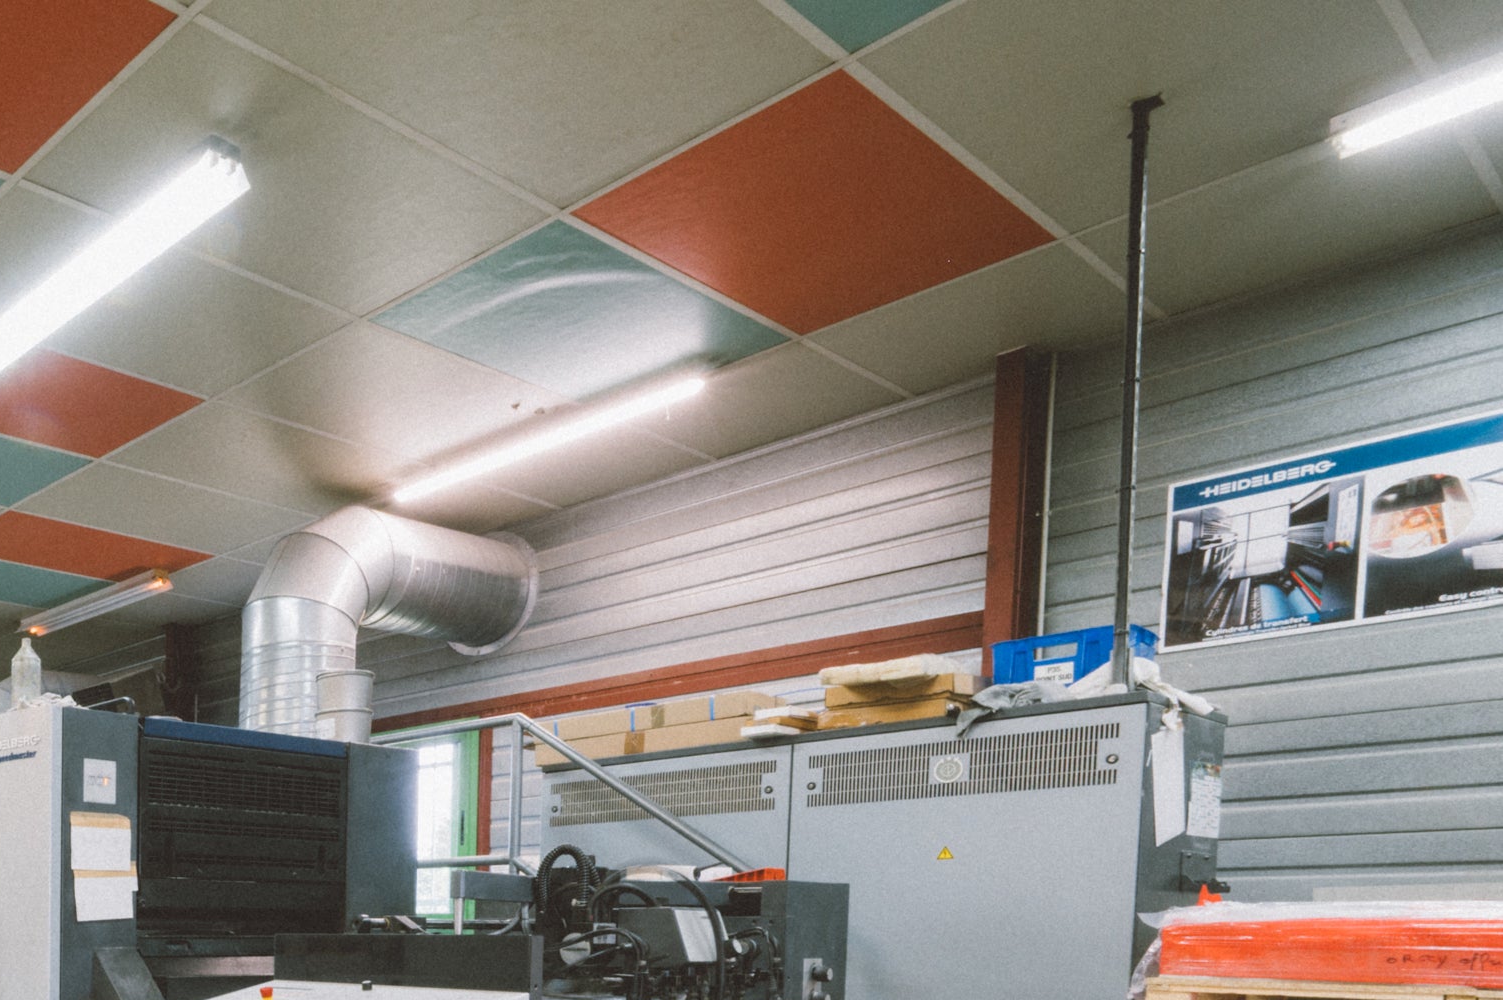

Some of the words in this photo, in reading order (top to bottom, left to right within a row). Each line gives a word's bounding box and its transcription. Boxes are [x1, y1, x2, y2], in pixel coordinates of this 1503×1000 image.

[1199, 460, 1336, 498] HEIDELBERG
[1438, 592, 1468, 602] Easy
[1205, 625, 1249, 637] Cylindres
[1263, 615, 1308, 628] transfert
